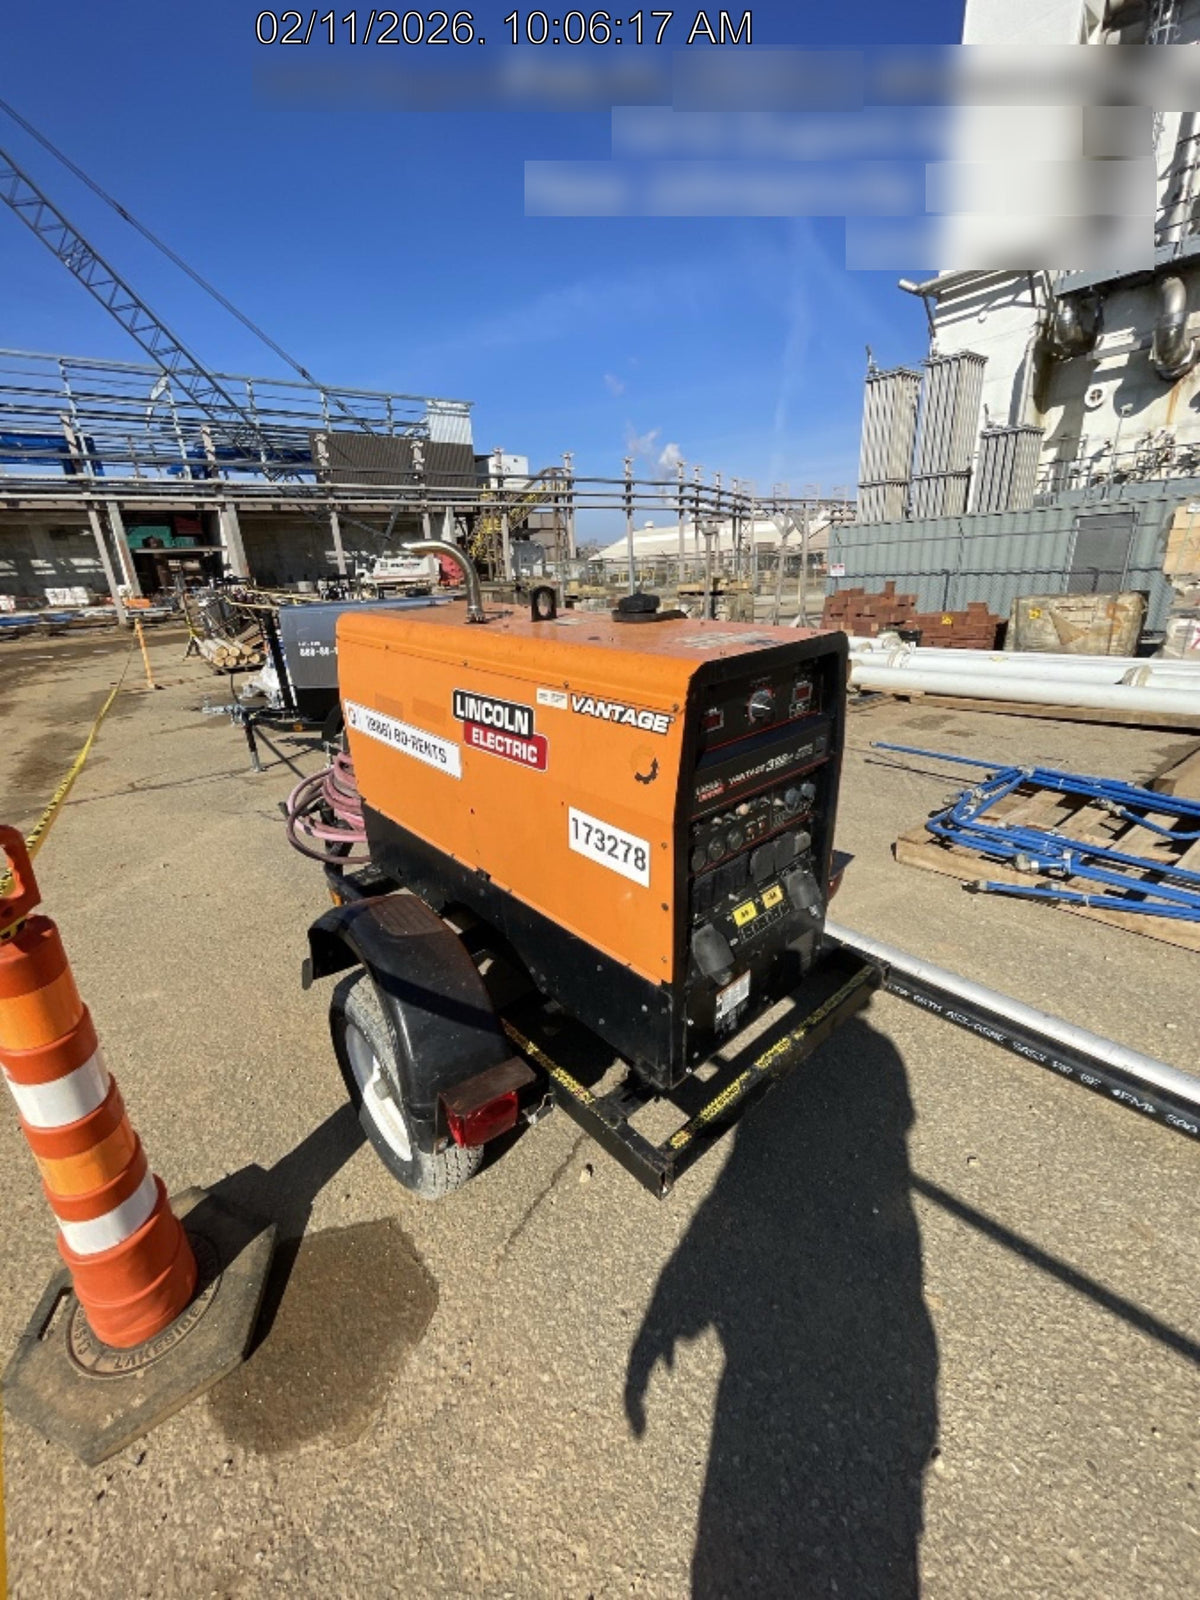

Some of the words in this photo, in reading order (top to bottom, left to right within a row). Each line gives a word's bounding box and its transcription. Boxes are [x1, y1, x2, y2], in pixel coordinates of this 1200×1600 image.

[455, 694, 530, 736] LINCOLN
[571, 693, 670, 735] VANTAGE
[471, 726, 538, 764] ELECTRIC
[571, 816, 646, 872] 173278
